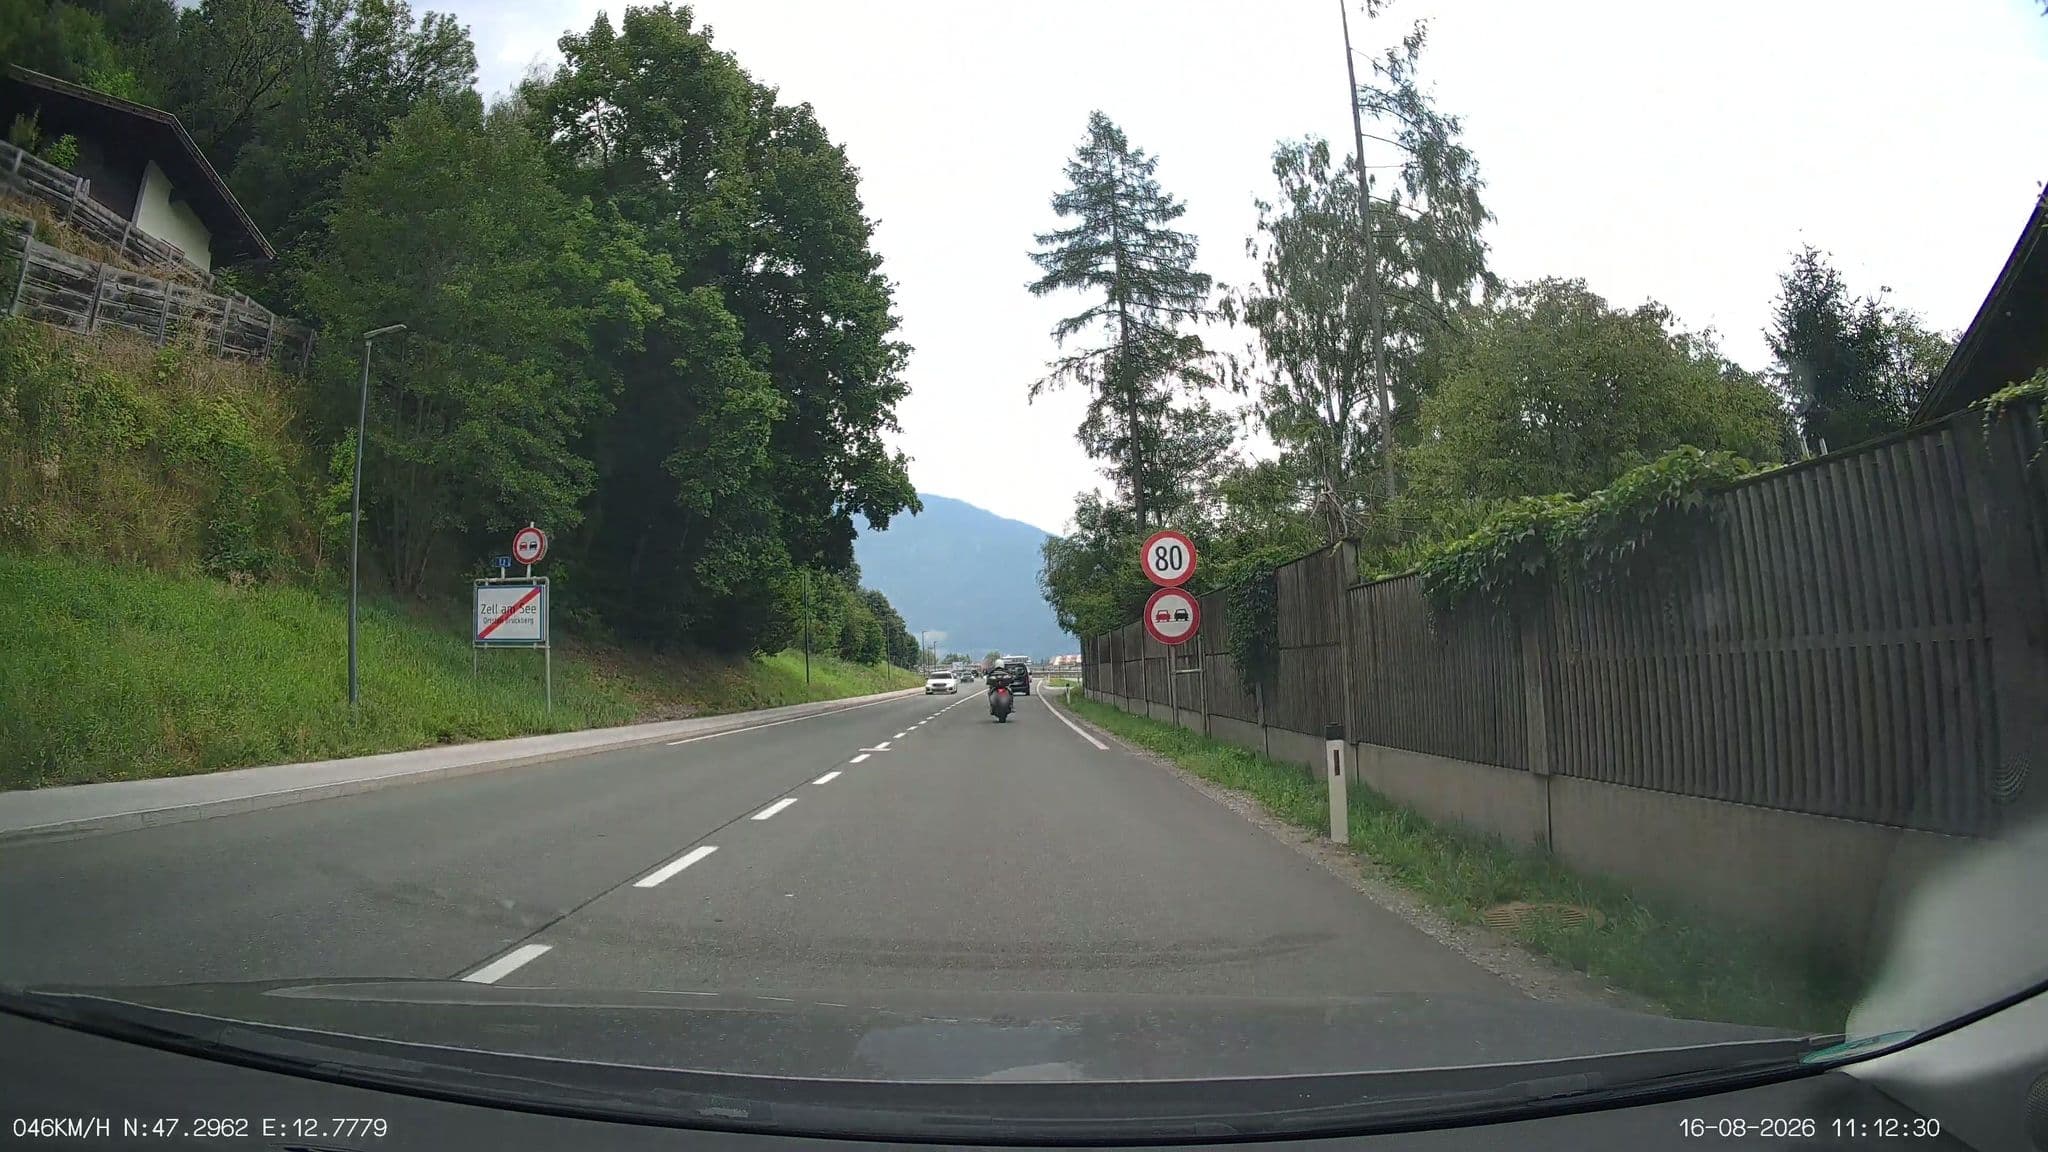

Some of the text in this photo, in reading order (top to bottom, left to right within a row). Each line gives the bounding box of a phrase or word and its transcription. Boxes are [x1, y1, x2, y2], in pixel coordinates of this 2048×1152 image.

[1155, 545, 1183, 572] 80
[480, 602, 537, 615] Zell am See
